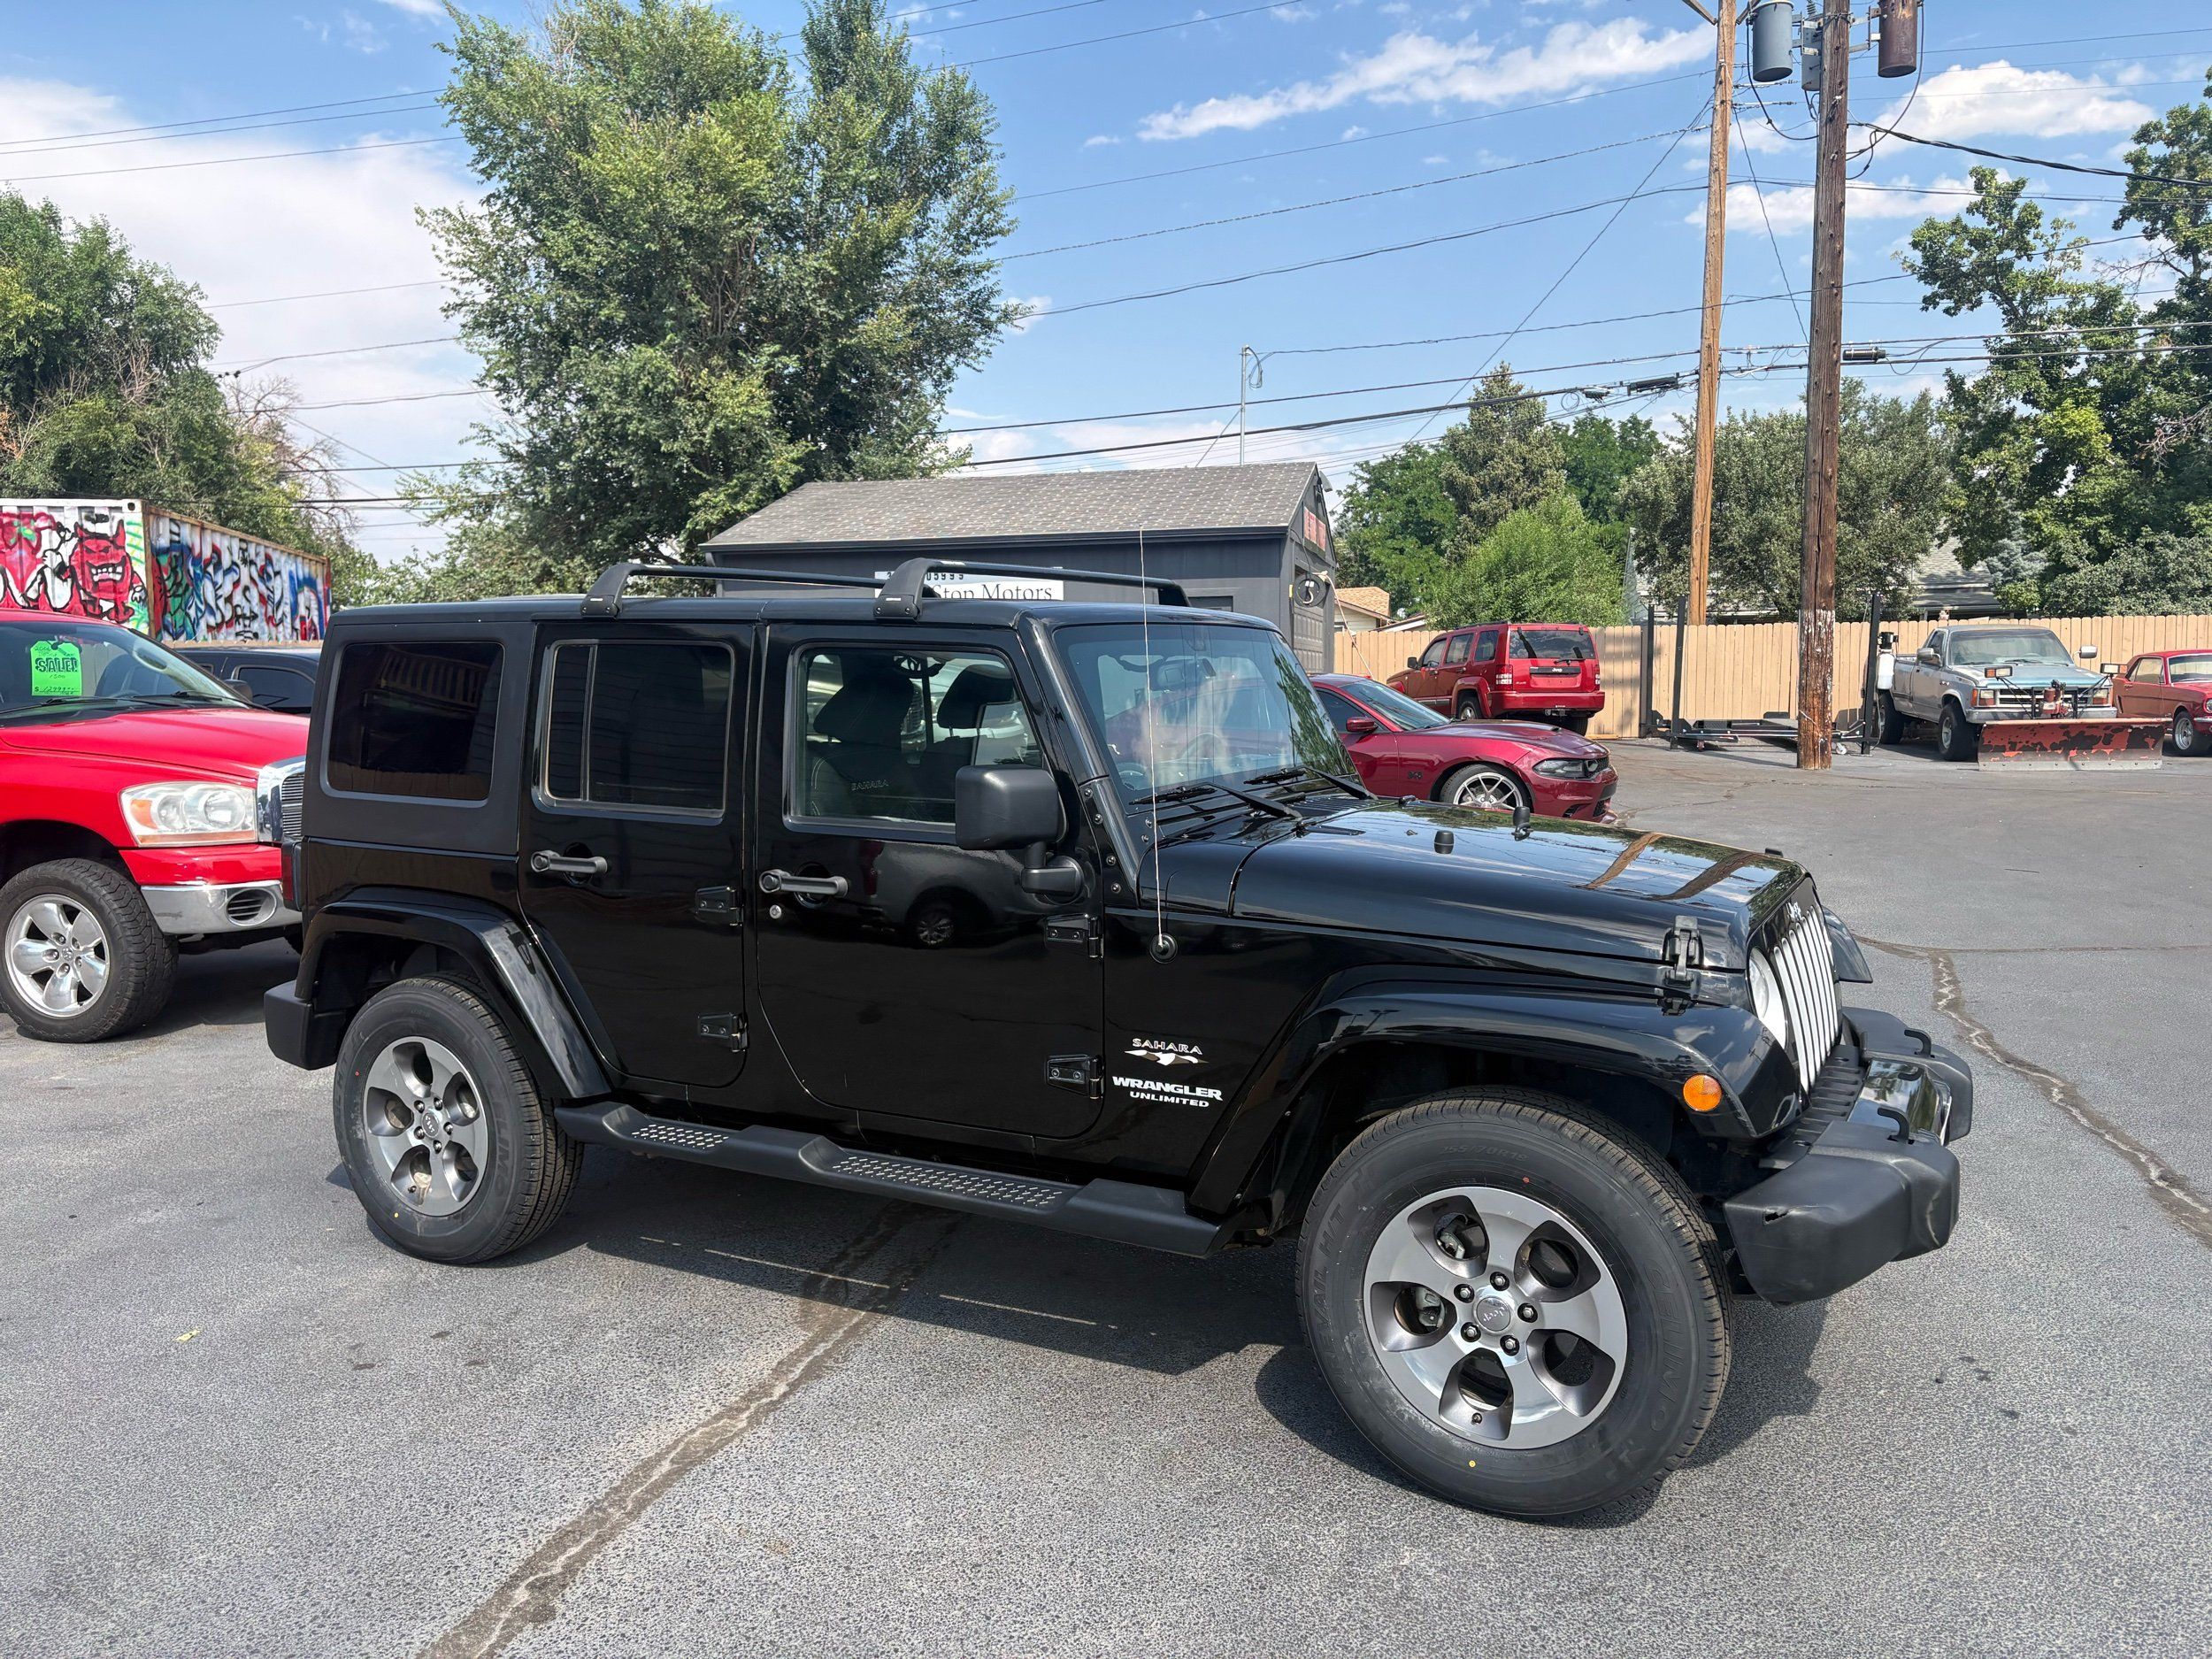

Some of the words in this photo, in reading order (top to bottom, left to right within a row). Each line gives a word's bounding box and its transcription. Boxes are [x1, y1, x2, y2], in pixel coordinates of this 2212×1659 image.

[982, 583, 1053, 600] Motors
[1133, 1038, 1202, 1055] SAHARA
[1112, 1076, 1223, 1101] WRANGLER
[1130, 1091, 1210, 1108] UNLIMITED
